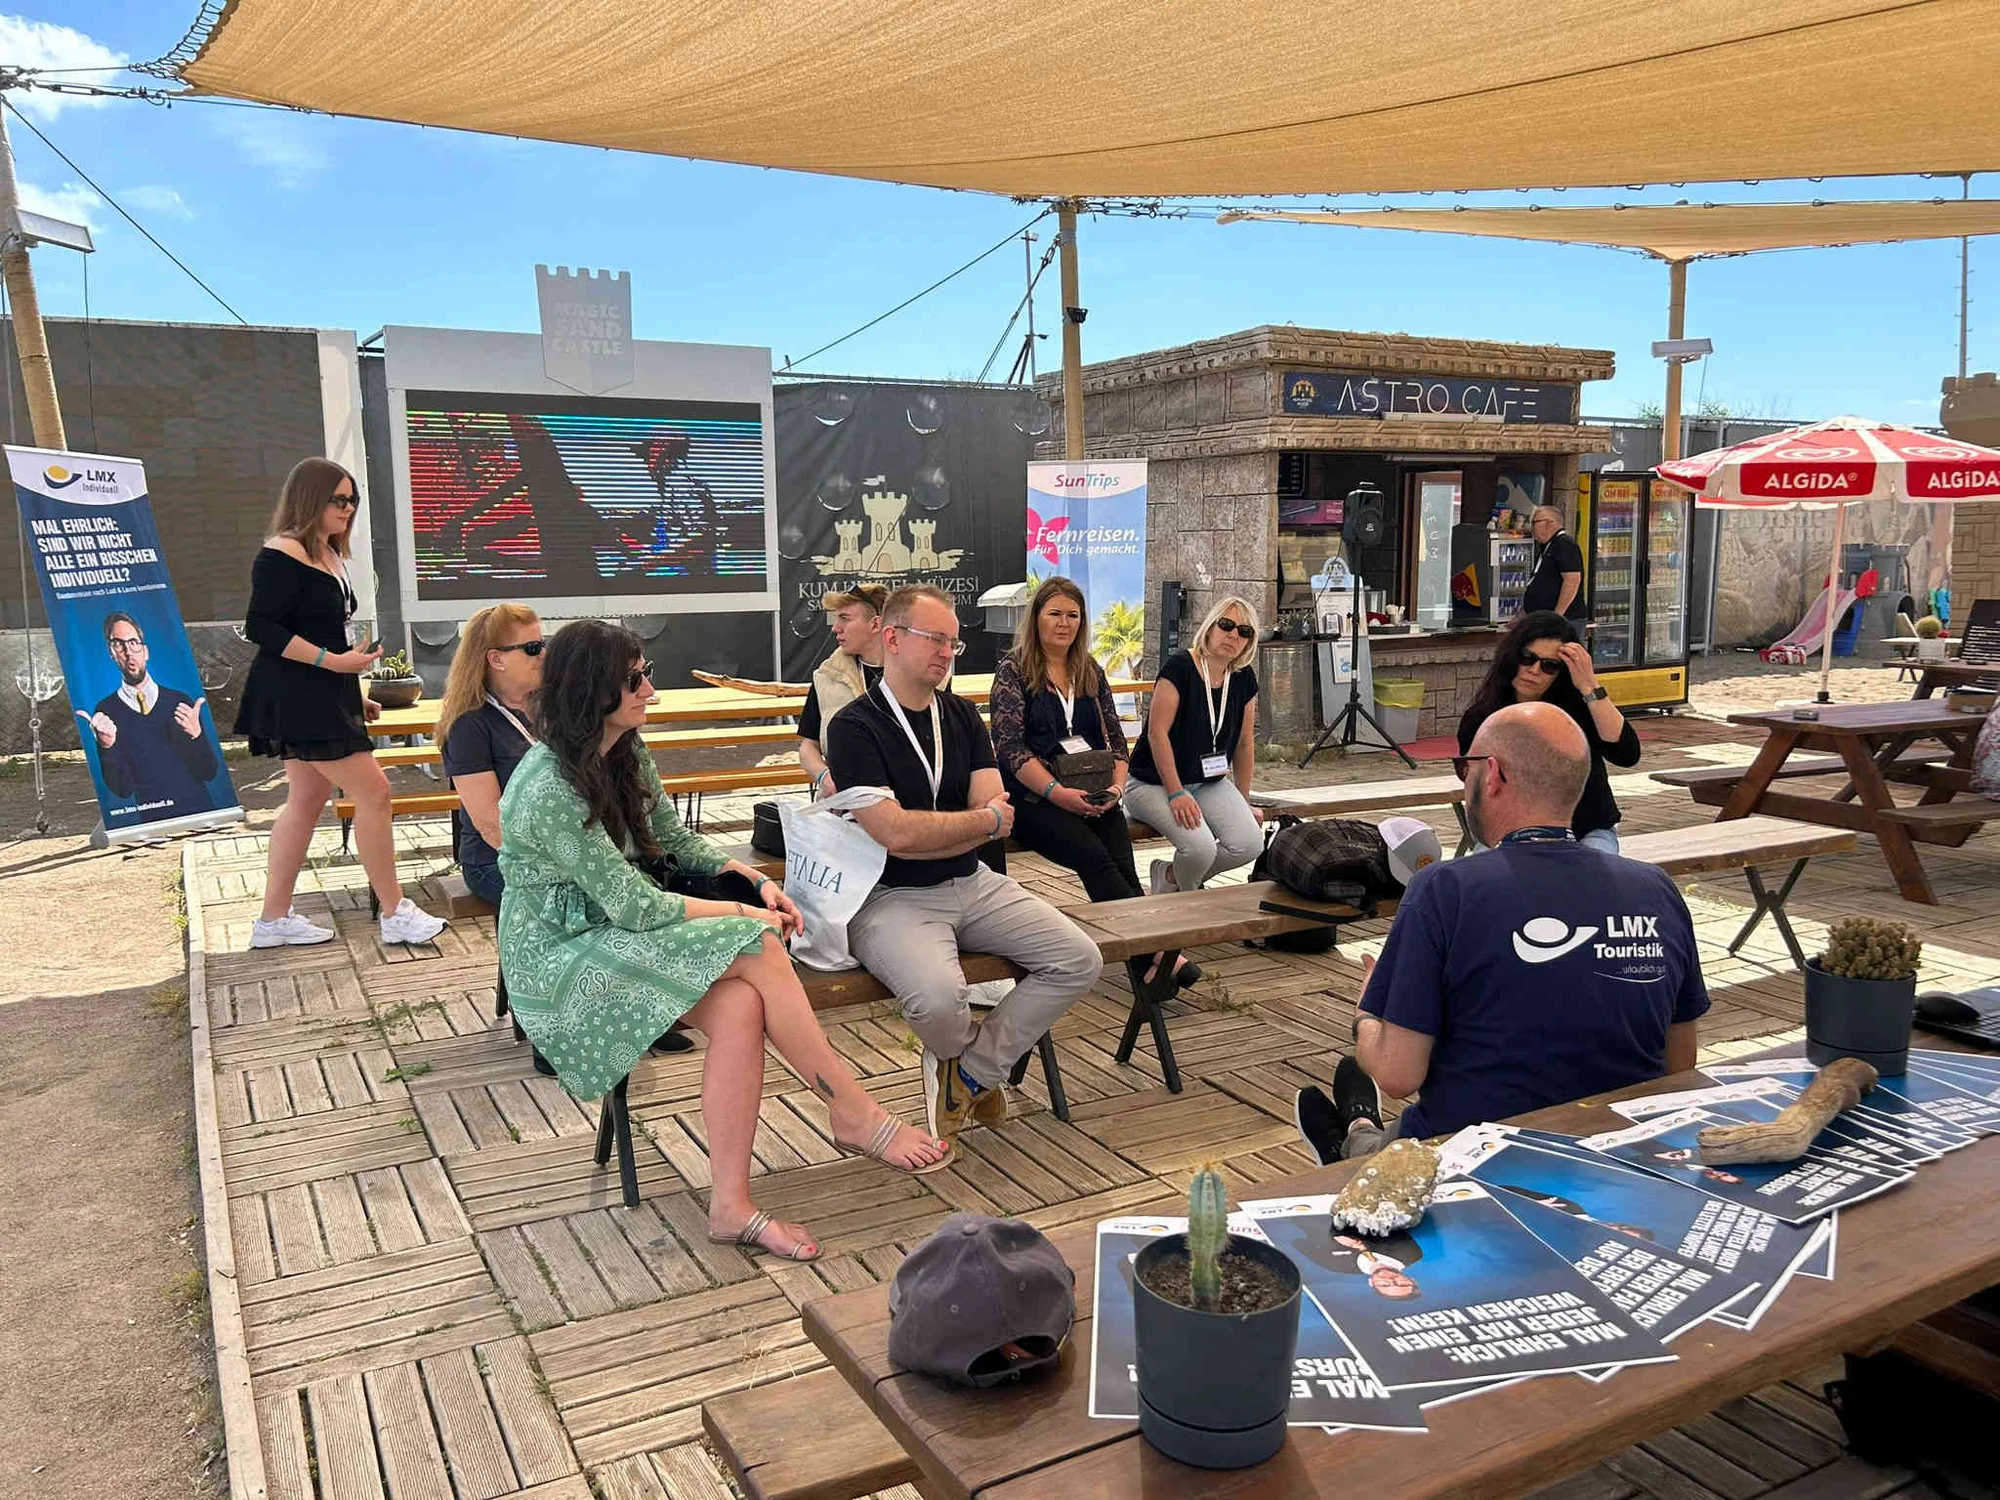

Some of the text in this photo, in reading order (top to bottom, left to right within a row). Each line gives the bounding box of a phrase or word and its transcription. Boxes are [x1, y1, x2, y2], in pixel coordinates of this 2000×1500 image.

[554, 301, 621, 319] MAGIC
[554, 318, 622, 338] SAND
[552, 337, 626, 356] CASTLE
[1337, 377, 1540, 419] ASTRO CAFE
[86, 469, 117, 483] LMX
[1055, 473, 1120, 490] SunTrips
[31, 517, 119, 535] MAL EHRLICH:
[1036, 526, 1140, 542] Fernreisen.
[37, 534, 133, 553] SIND WIR NICHT
[1057, 543, 1082, 555] Dich
[1086, 543, 1140, 556] gemacht.
[45, 549, 158, 571] ALLE EIN BISSCHEN
[49, 568, 131, 588] INDIVIDUELL?
[1606, 916, 1659, 938] LMX
[1593, 942, 1664, 959] Touristik
[1593, 1239, 1630, 1262] AUF
[1616, 1249, 1658, 1272] DER
[1627, 1258, 1685, 1294] PAPIER
[1630, 1267, 1713, 1329] MAL EHRLIC
[1386, 1291, 1586, 1334] WEICHEN KERN!
[1386, 1306, 1602, 1353] JEDER HAT EINEN
[1443, 1321, 1628, 1364] MAL EHRLICH:
[1316, 1379, 1391, 1399] MAL
